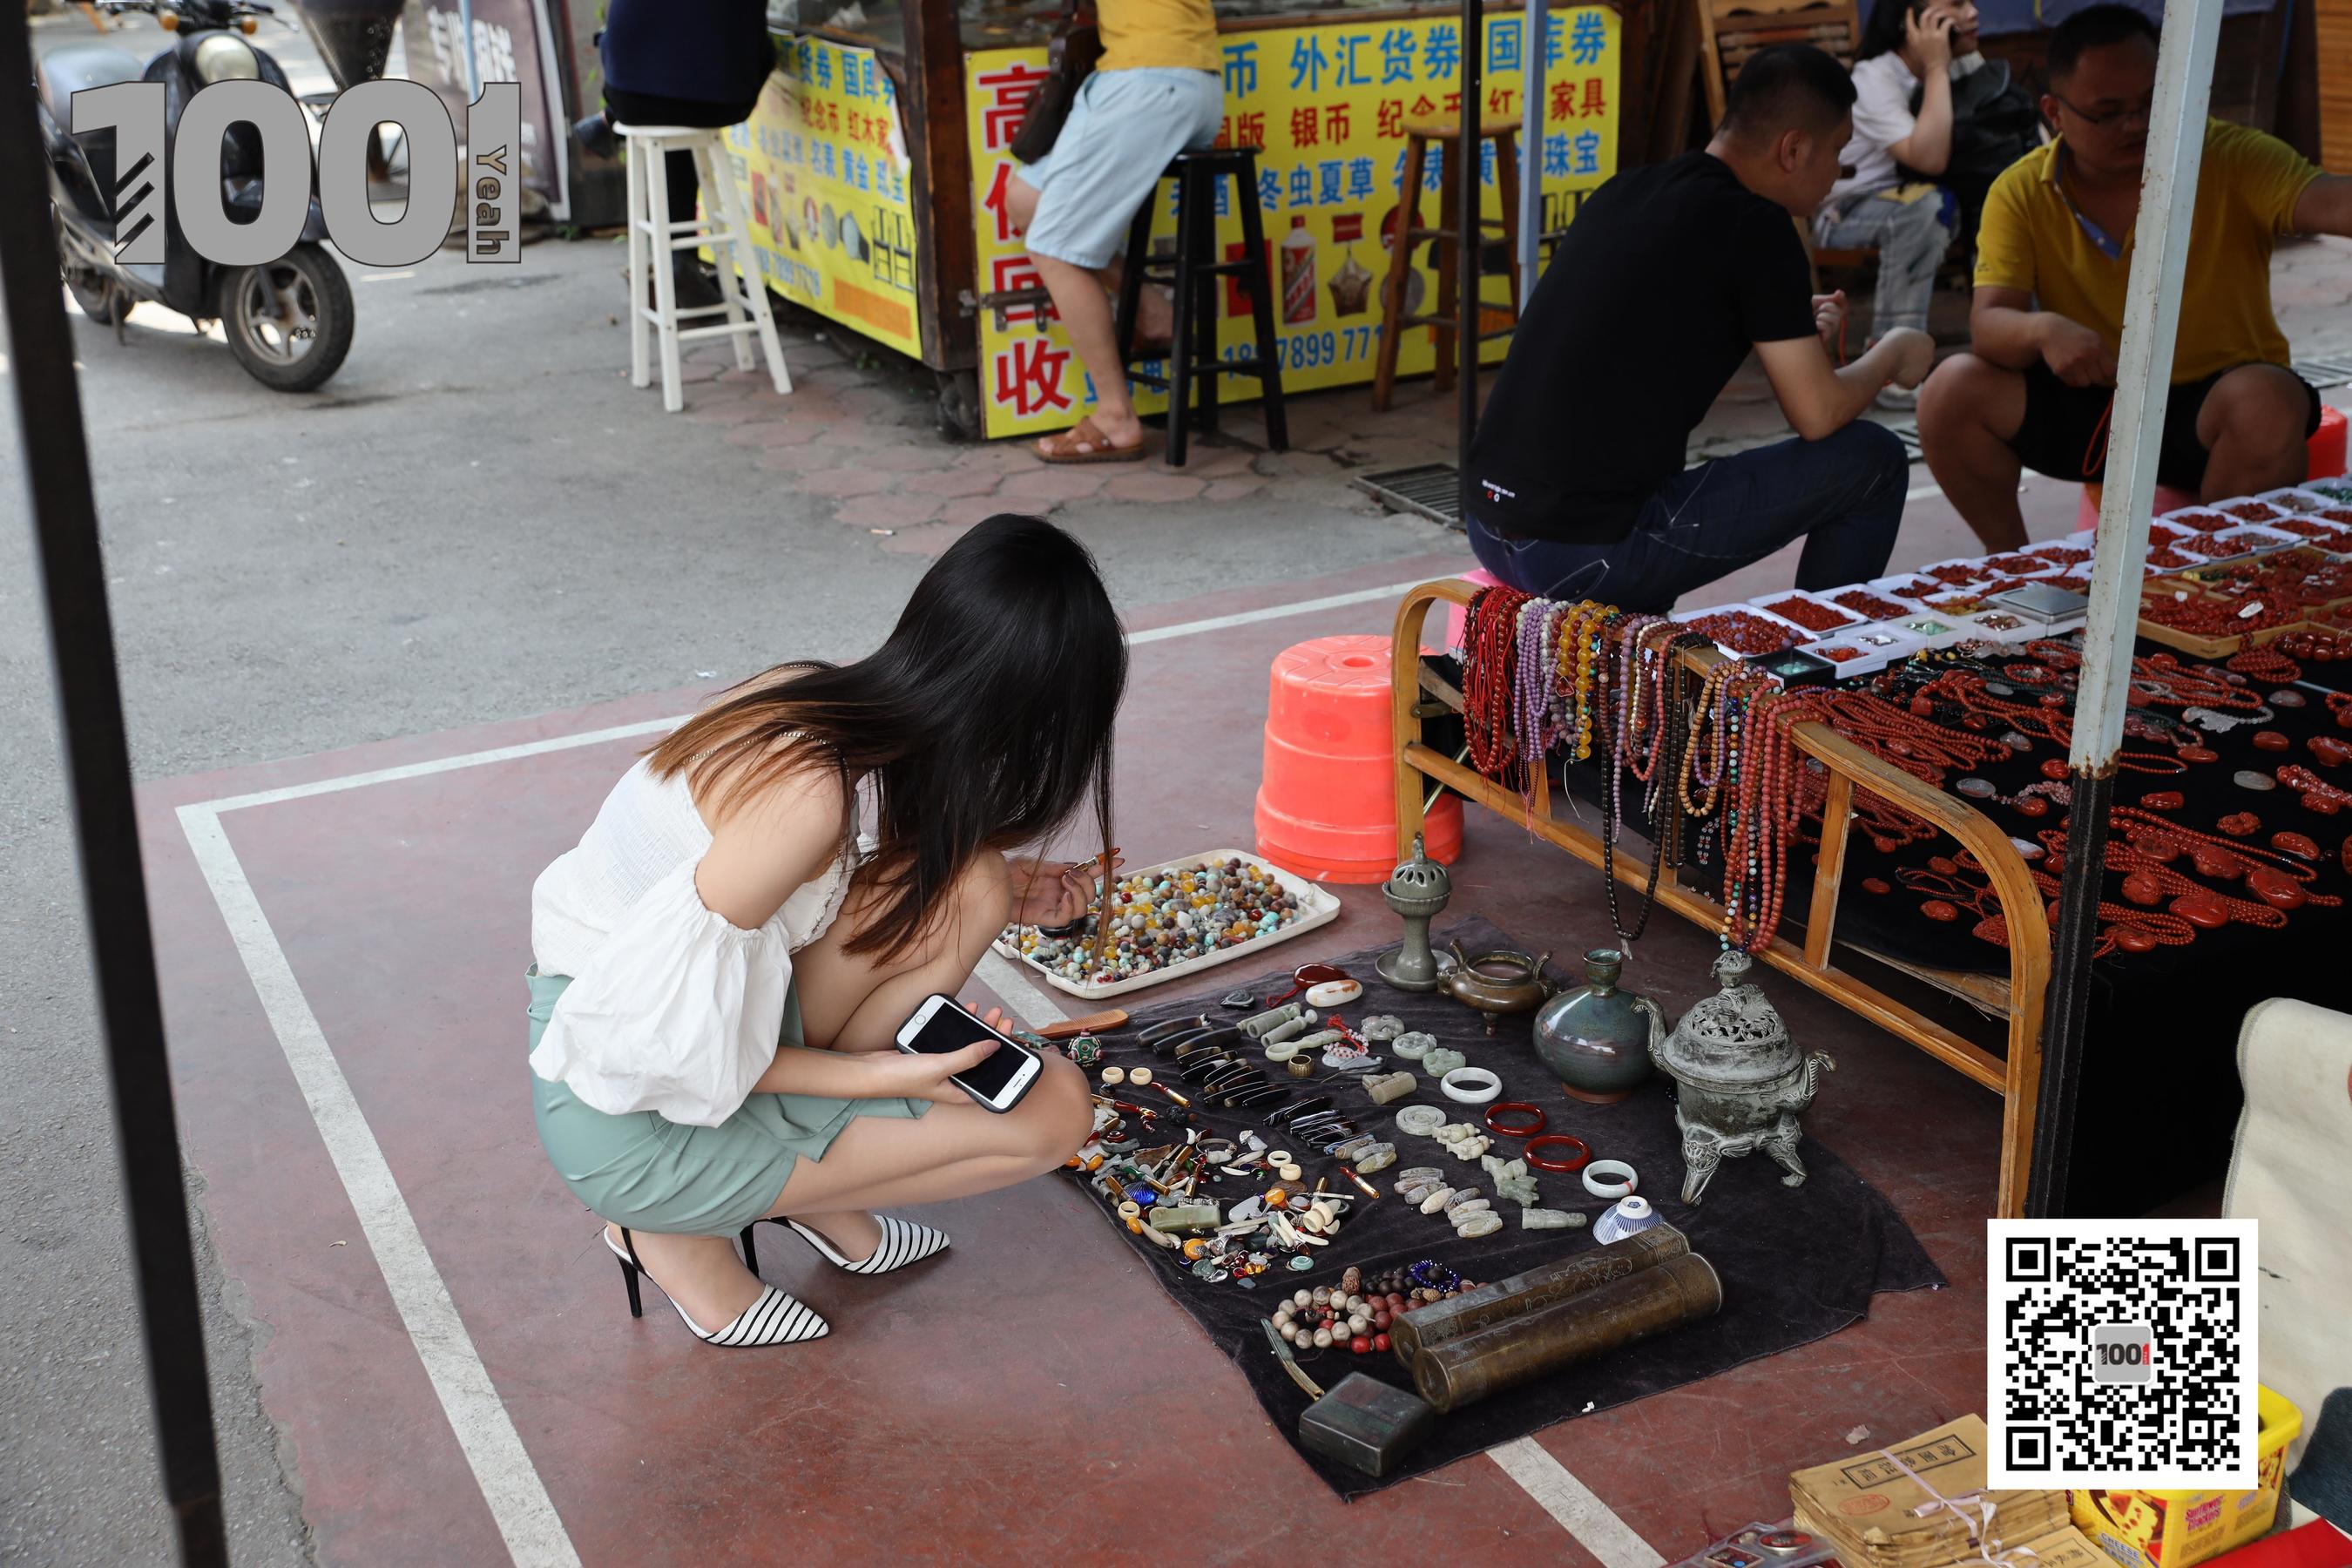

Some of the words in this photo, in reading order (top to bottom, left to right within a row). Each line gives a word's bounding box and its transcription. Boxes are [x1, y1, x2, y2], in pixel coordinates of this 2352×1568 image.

[1289, 24, 1460, 92] 外汇货券
[1290, 102, 1351, 149] 银币
[1258, 157, 1375, 211] 冬虫夏草
[1544, 131, 1599, 178] 珠宝
[1224, 330, 1335, 381] 187899
